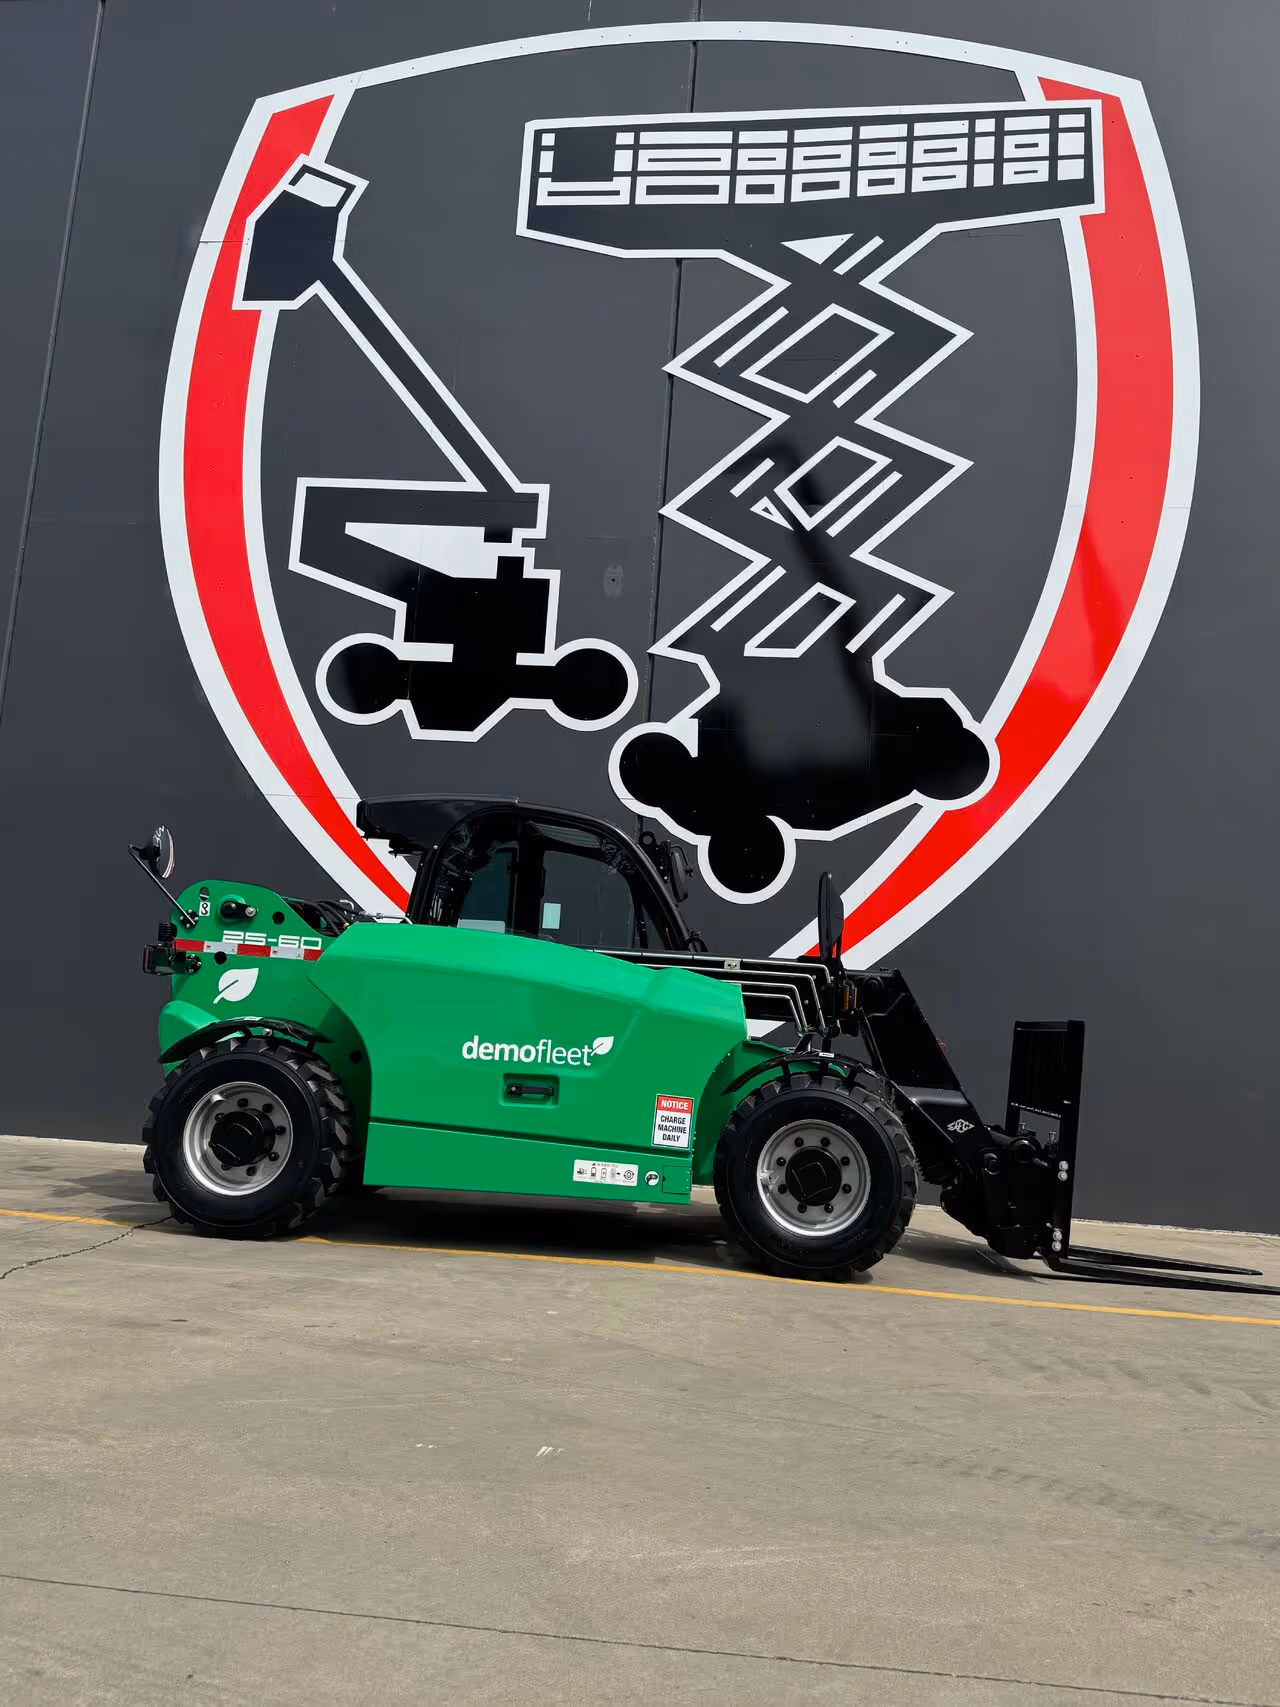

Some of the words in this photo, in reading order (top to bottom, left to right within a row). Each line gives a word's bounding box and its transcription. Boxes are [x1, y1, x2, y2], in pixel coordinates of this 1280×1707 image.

[222, 930, 322, 950] 25-60
[462, 1035, 592, 1066] demofleet
[661, 1099, 689, 1110] NOTICE
[660, 1115, 686, 1125] CHARGE
[658, 1124, 687, 1134] MACHINE
[662, 1133, 680, 1142] DAILY
